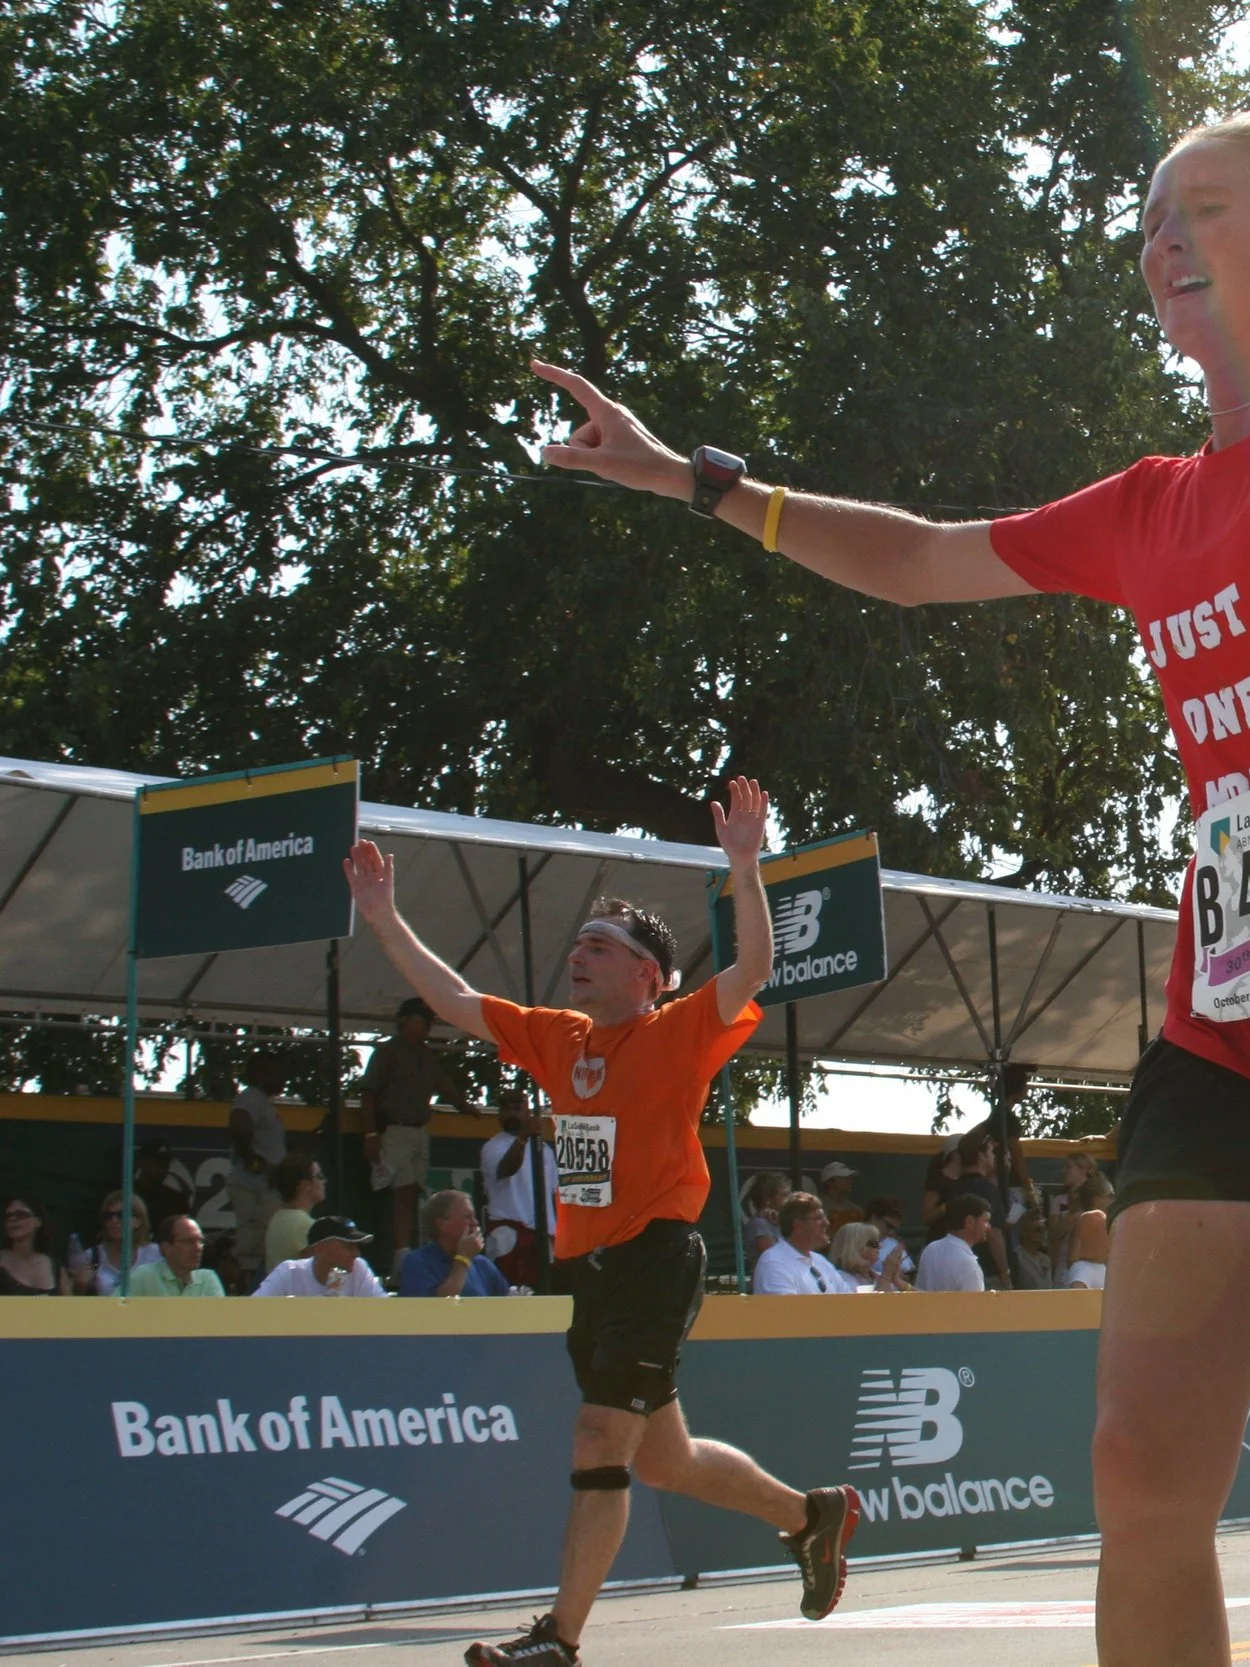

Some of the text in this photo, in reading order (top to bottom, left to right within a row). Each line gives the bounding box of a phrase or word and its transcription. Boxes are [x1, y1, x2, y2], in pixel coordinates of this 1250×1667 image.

[1149, 582, 1247, 669] JUST
[182, 832, 314, 871] Bank of America
[1197, 865, 1224, 948] B
[783, 950, 858, 985] balance
[1213, 989, 1250, 1010] October
[556, 1135, 610, 1172] 20558
[111, 1392, 520, 1457] Bank of America
[891, 1472, 1054, 1520] balance
